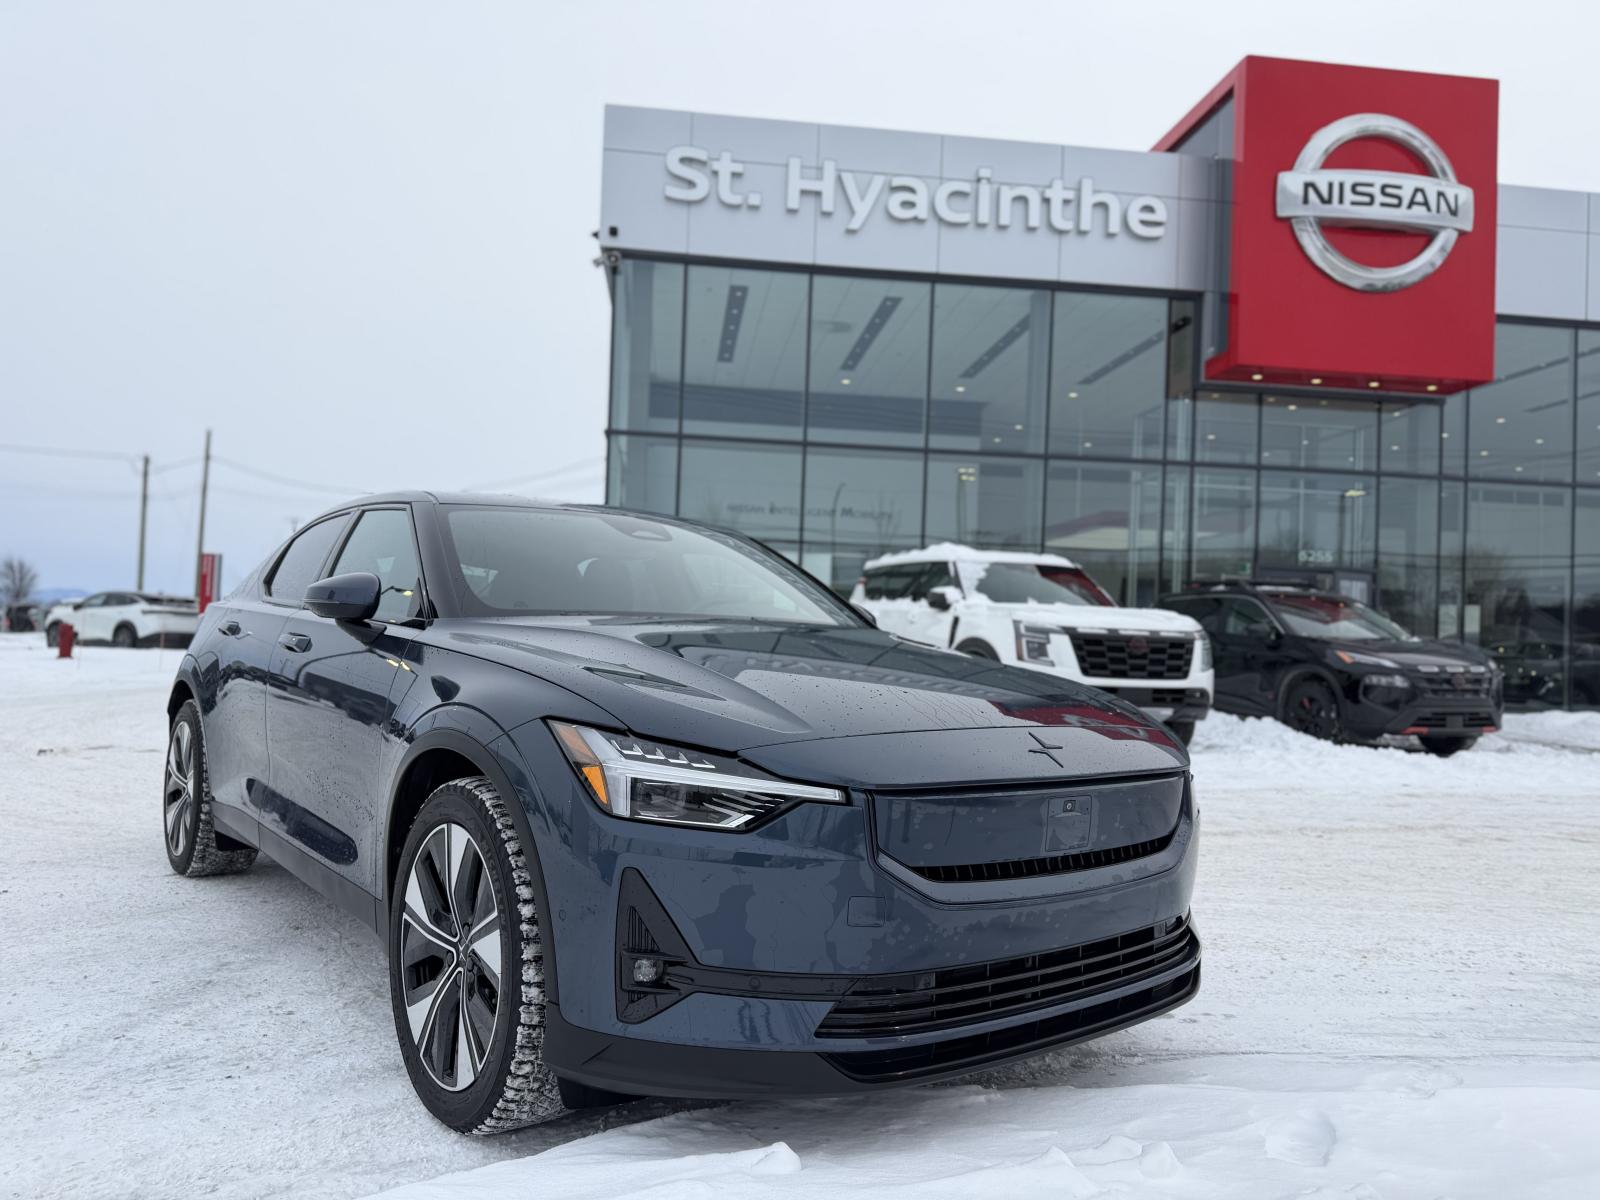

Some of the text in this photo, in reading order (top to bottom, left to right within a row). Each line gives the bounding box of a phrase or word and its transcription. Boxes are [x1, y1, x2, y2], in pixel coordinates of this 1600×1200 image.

[664, 146, 1167, 238] St. Hyacinthe
[1302, 180, 1459, 217] NISSAN
